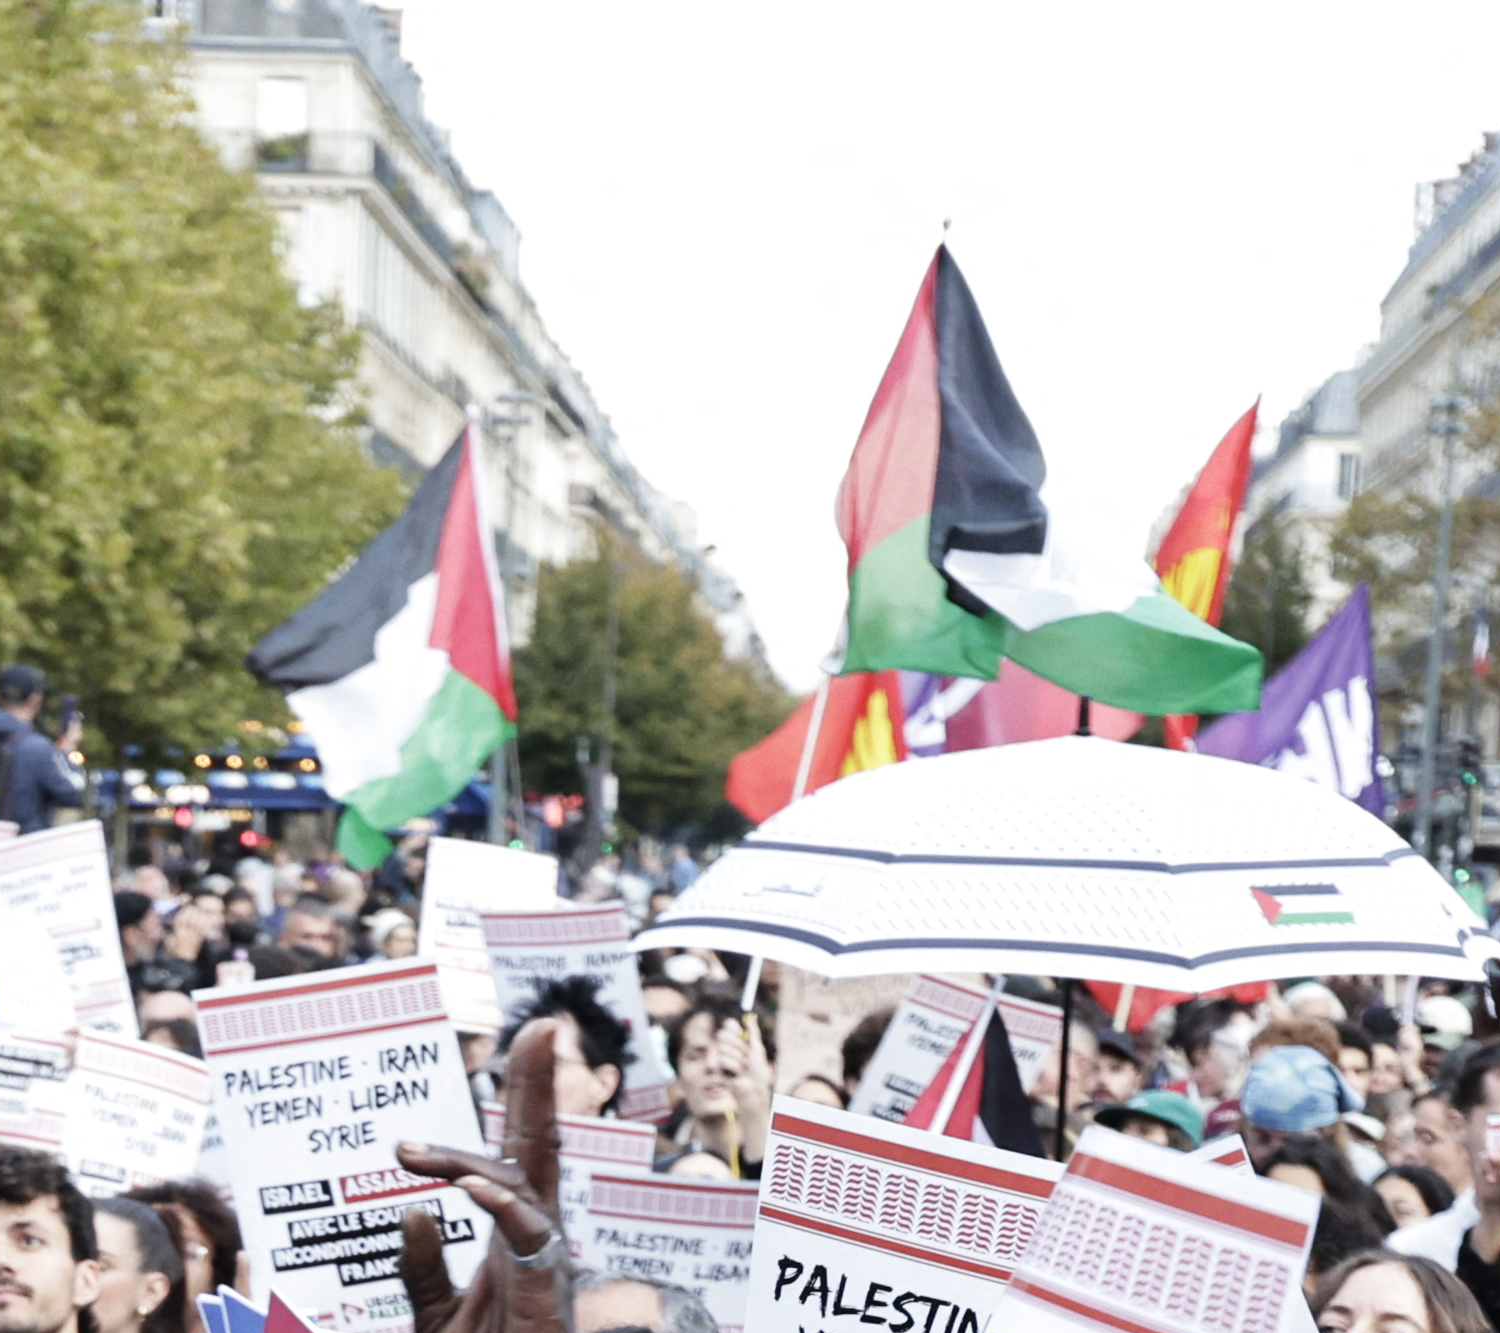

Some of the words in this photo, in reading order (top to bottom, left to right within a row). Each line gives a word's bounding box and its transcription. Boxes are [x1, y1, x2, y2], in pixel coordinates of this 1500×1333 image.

[225, 1056, 351, 1096] PALESTINE
[379, 1042, 439, 1074] IRAN
[246, 1096, 323, 1127] YEMEN
[350, 1079, 429, 1112] LIBAN
[309, 1122, 376, 1152] SYRIE
[263, 1182, 330, 1208] ISRAEL
[292, 1219, 337, 1240] AVEC
[338, 1214, 362, 1233] LE
[594, 1226, 706, 1256] PALESTINE
[275, 1231, 404, 1267] INCONDITIONNE
[446, 1221, 471, 1239] LA
[342, 1256, 400, 1282] FRANC
[607, 1254, 675, 1276] YEMEN
